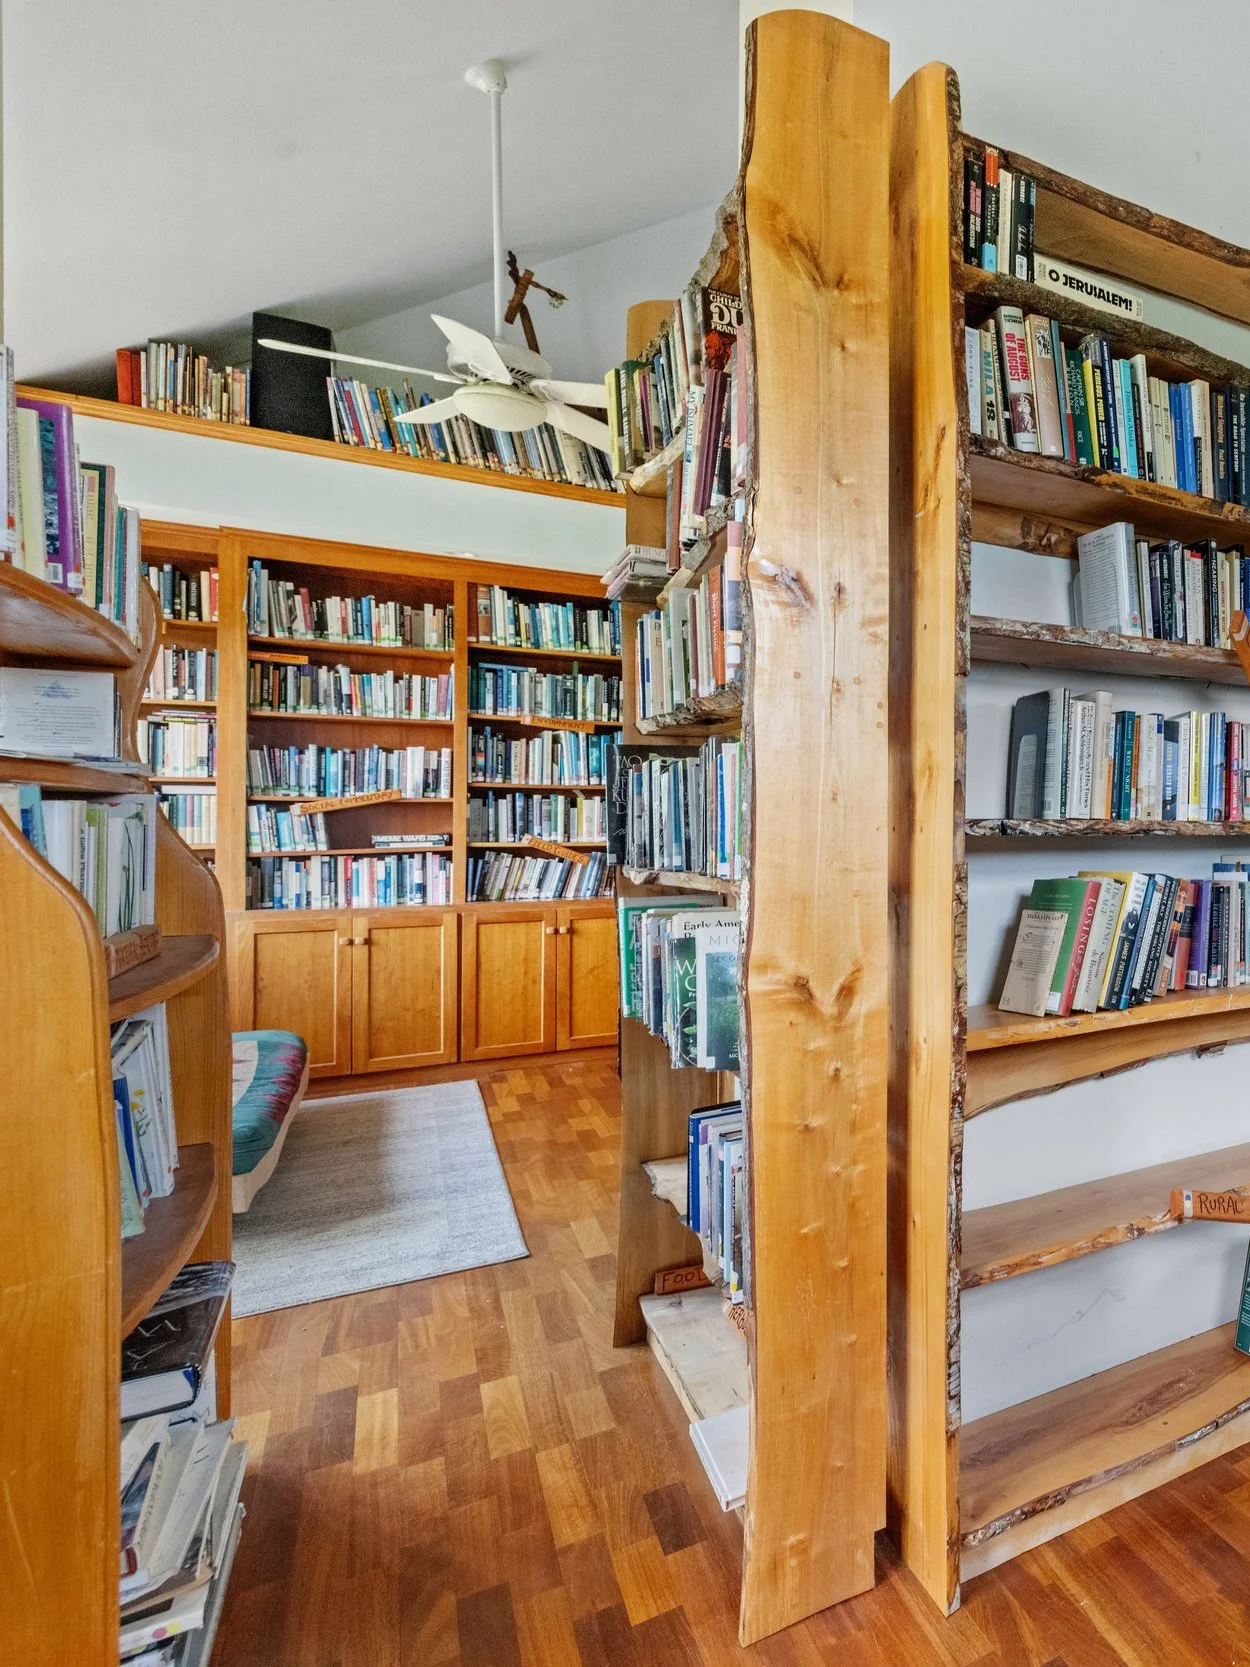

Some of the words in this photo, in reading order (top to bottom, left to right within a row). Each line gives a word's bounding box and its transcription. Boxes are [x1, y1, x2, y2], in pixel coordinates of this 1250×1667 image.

[710, 294, 742, 309] CHILD
[1049, 269, 1060, 282] O
[1063, 274, 1132, 312] JERUSALEM!
[710, 302, 743, 328] DU
[1005, 333, 1015, 344] OF
[1017, 338, 1025, 353] THE
[984, 351, 993, 395] MILA
[1007, 346, 1020, 382] AUGUST
[1019, 356, 1029, 380] GUNS
[1094, 369, 1102, 398] PERILOUS
[687, 391, 696, 406] MY
[987, 400, 995, 421] 18
[1096, 399, 1104, 421] POWER
[686, 407, 695, 446] ISHMAEL
[613, 755, 642, 768] TAO
[300, 802, 336, 813] SOCIAL
[339, 790, 394, 805] COMMENTARY
[529, 837, 553, 852] FIELD
[554, 844, 584, 863] GUIDES
[1105, 882, 1113, 895] OF
[1162, 881, 1170, 903] ROBERT
[1161, 892, 1174, 931] UNREDEEMED
[683, 921, 711, 930] Early
[1077, 898, 1096, 954] LOSING
[1102, 904, 1117, 945] COMING
[1121, 941, 1130, 960] JAMES
[1150, 935, 1160, 959] SIBLING
[1156, 932, 1165, 957] CAPTIVE
[1084, 959, 1096, 994] Beauvoir
[1094, 951, 1105, 980] Simone
[1114, 961, 1126, 992] PATTERSON
[1143, 961, 1153, 987] SOCIETY
[1197, 1193, 1244, 1215] RURAL
